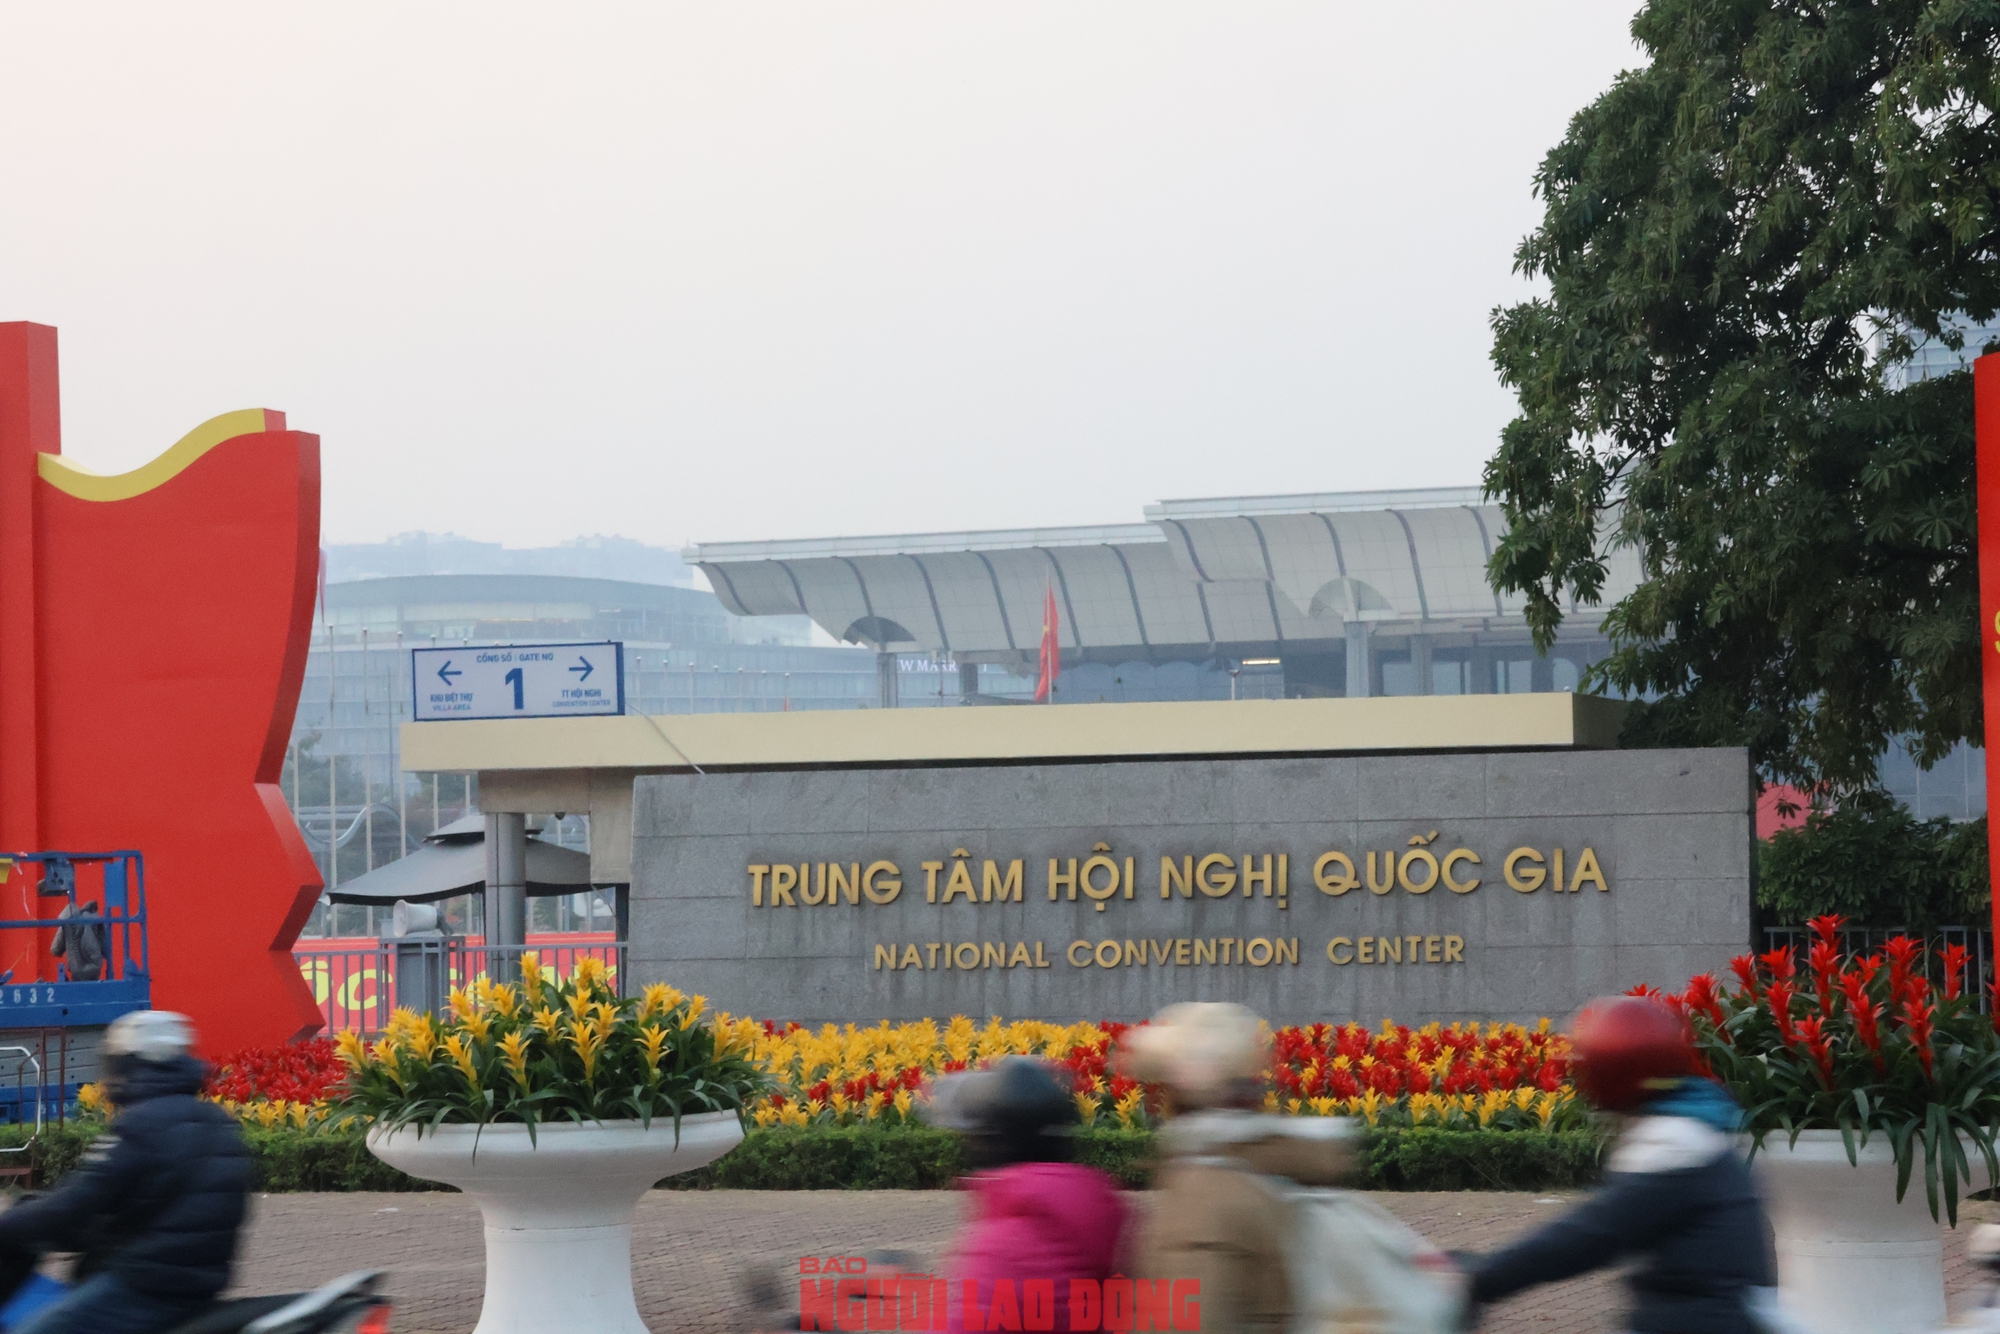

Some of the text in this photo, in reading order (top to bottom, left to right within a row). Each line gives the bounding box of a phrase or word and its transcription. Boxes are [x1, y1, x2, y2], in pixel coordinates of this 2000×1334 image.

[519, 653, 540, 662] GATE
[505, 668, 524, 710] 1
[748, 830, 1609, 912] TRUNG TÂM HỘI NGHỊ QUỐC GIA
[874, 935, 1465, 970] NATIONAL CONVENTION CENTER
